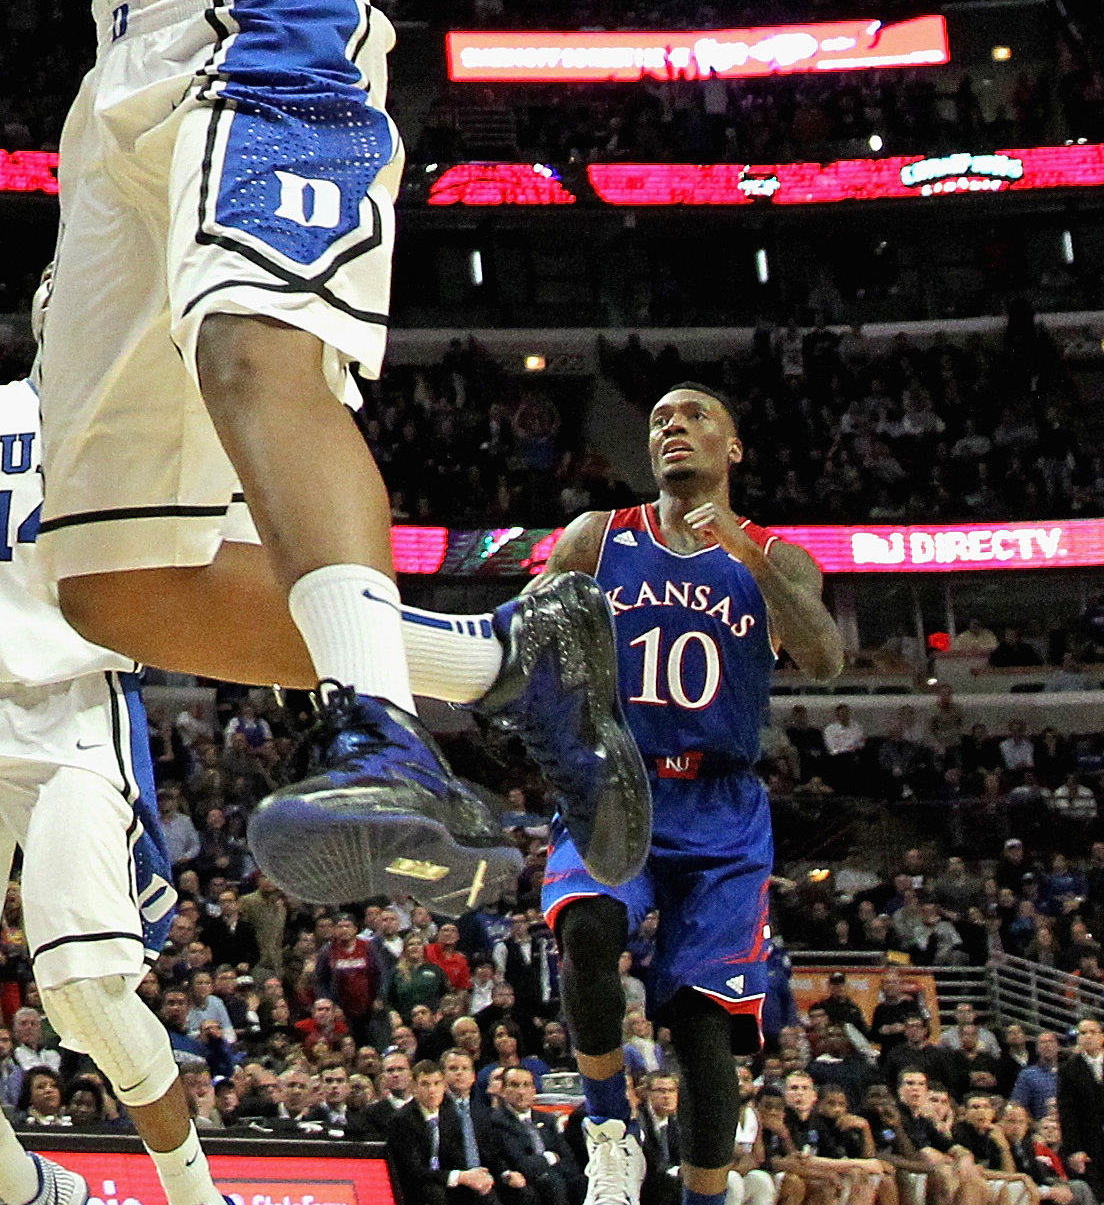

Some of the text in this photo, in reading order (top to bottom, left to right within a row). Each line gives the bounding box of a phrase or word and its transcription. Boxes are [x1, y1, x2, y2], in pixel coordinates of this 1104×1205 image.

[273, 169, 342, 229] D
[605, 580, 756, 638] KANSAS
[628, 627, 722, 710] 10
[665, 756, 690, 772] KU
